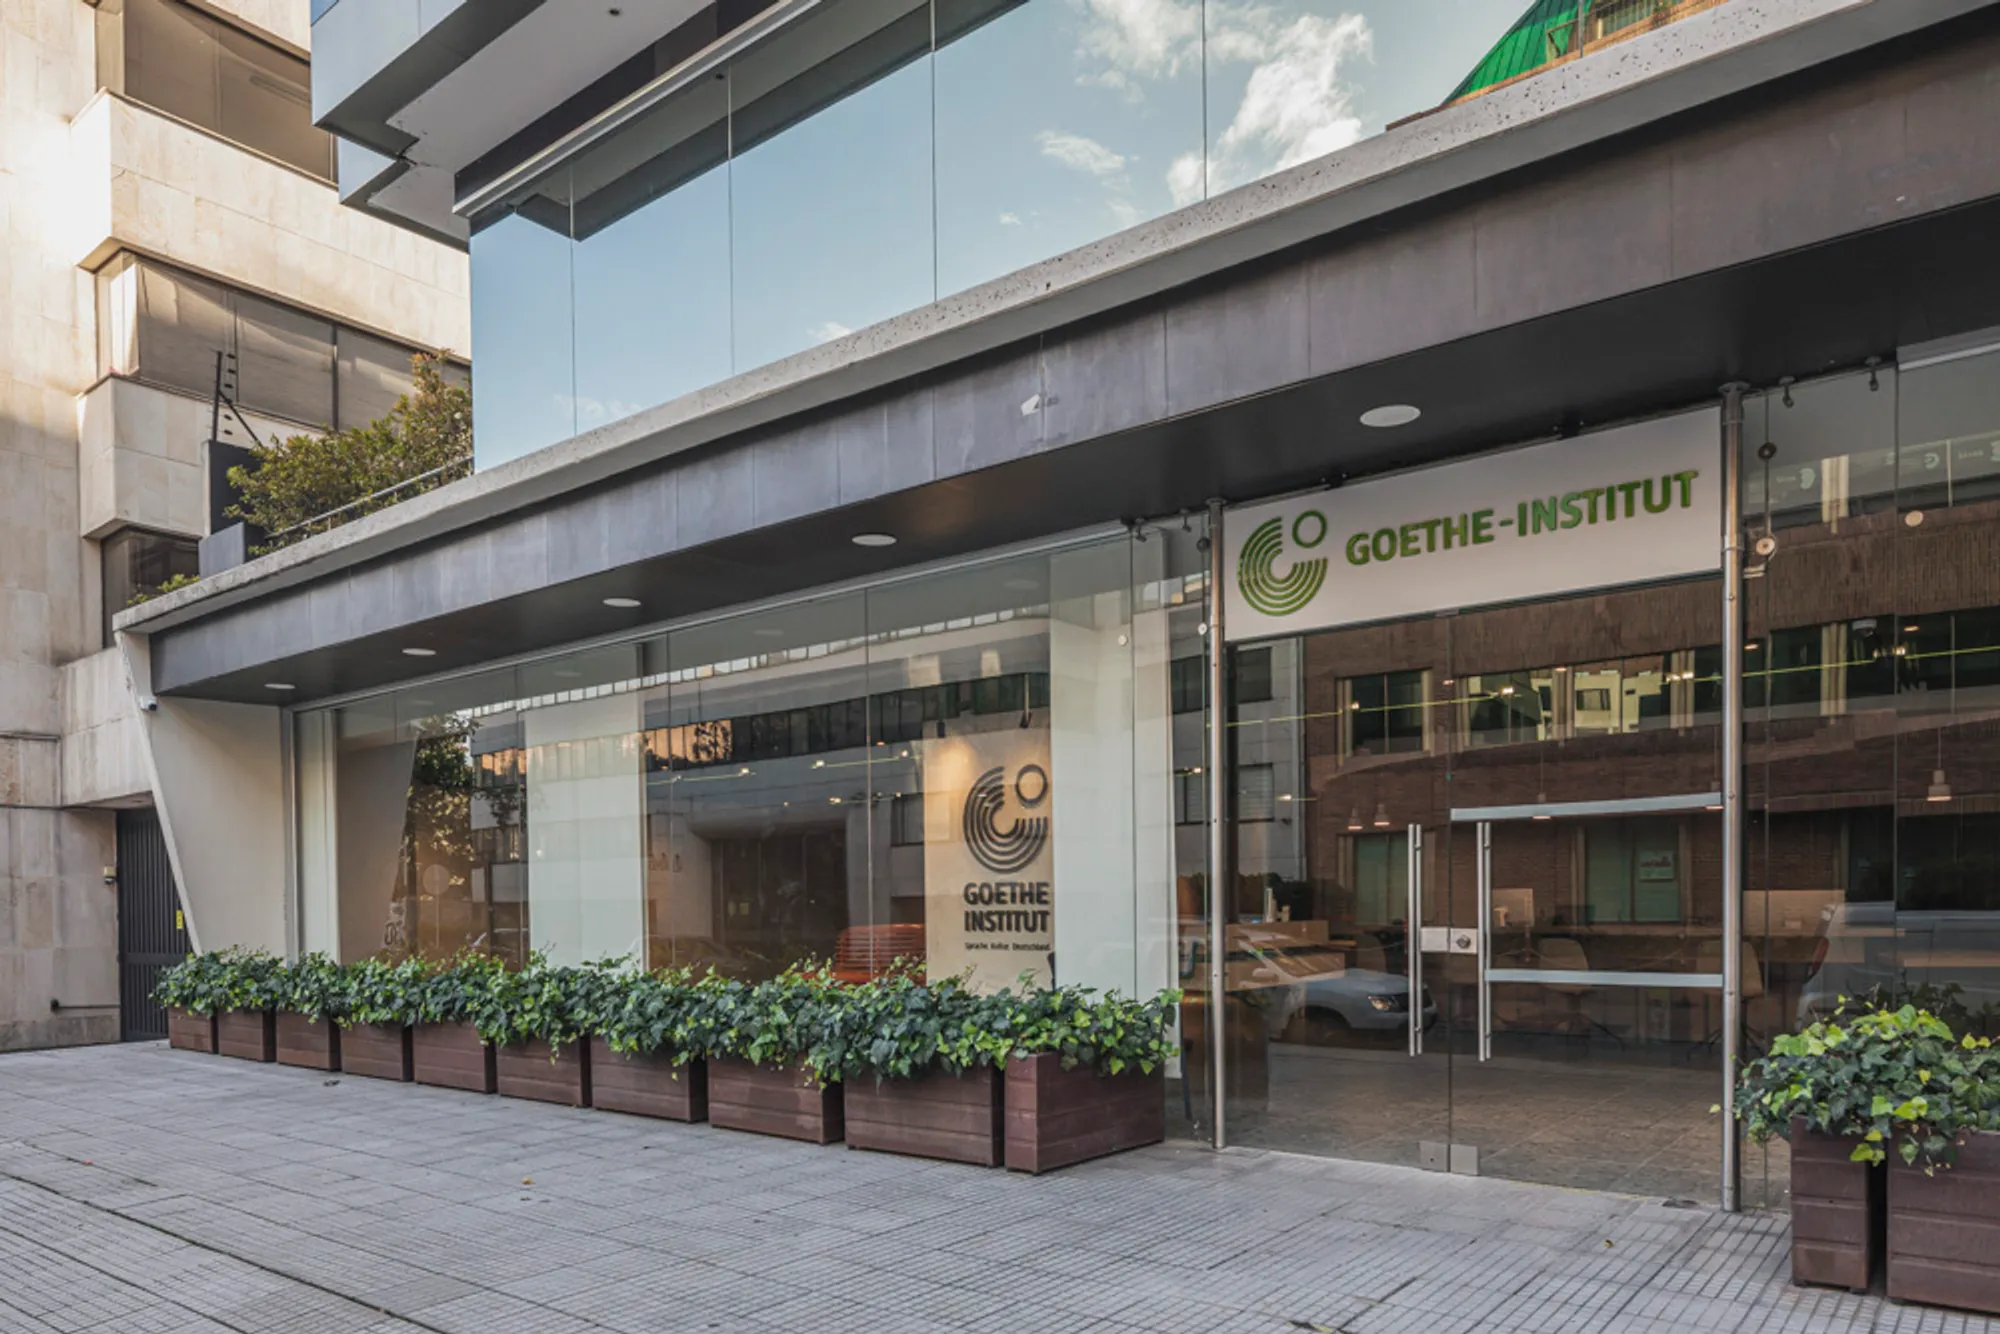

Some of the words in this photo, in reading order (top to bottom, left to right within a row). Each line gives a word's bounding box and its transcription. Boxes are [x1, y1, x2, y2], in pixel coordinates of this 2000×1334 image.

[1345, 469, 1699, 566] GOETHE-INSTITUT
[964, 881, 1050, 905] GOETHE
[964, 909, 1050, 933] INSTITUT
